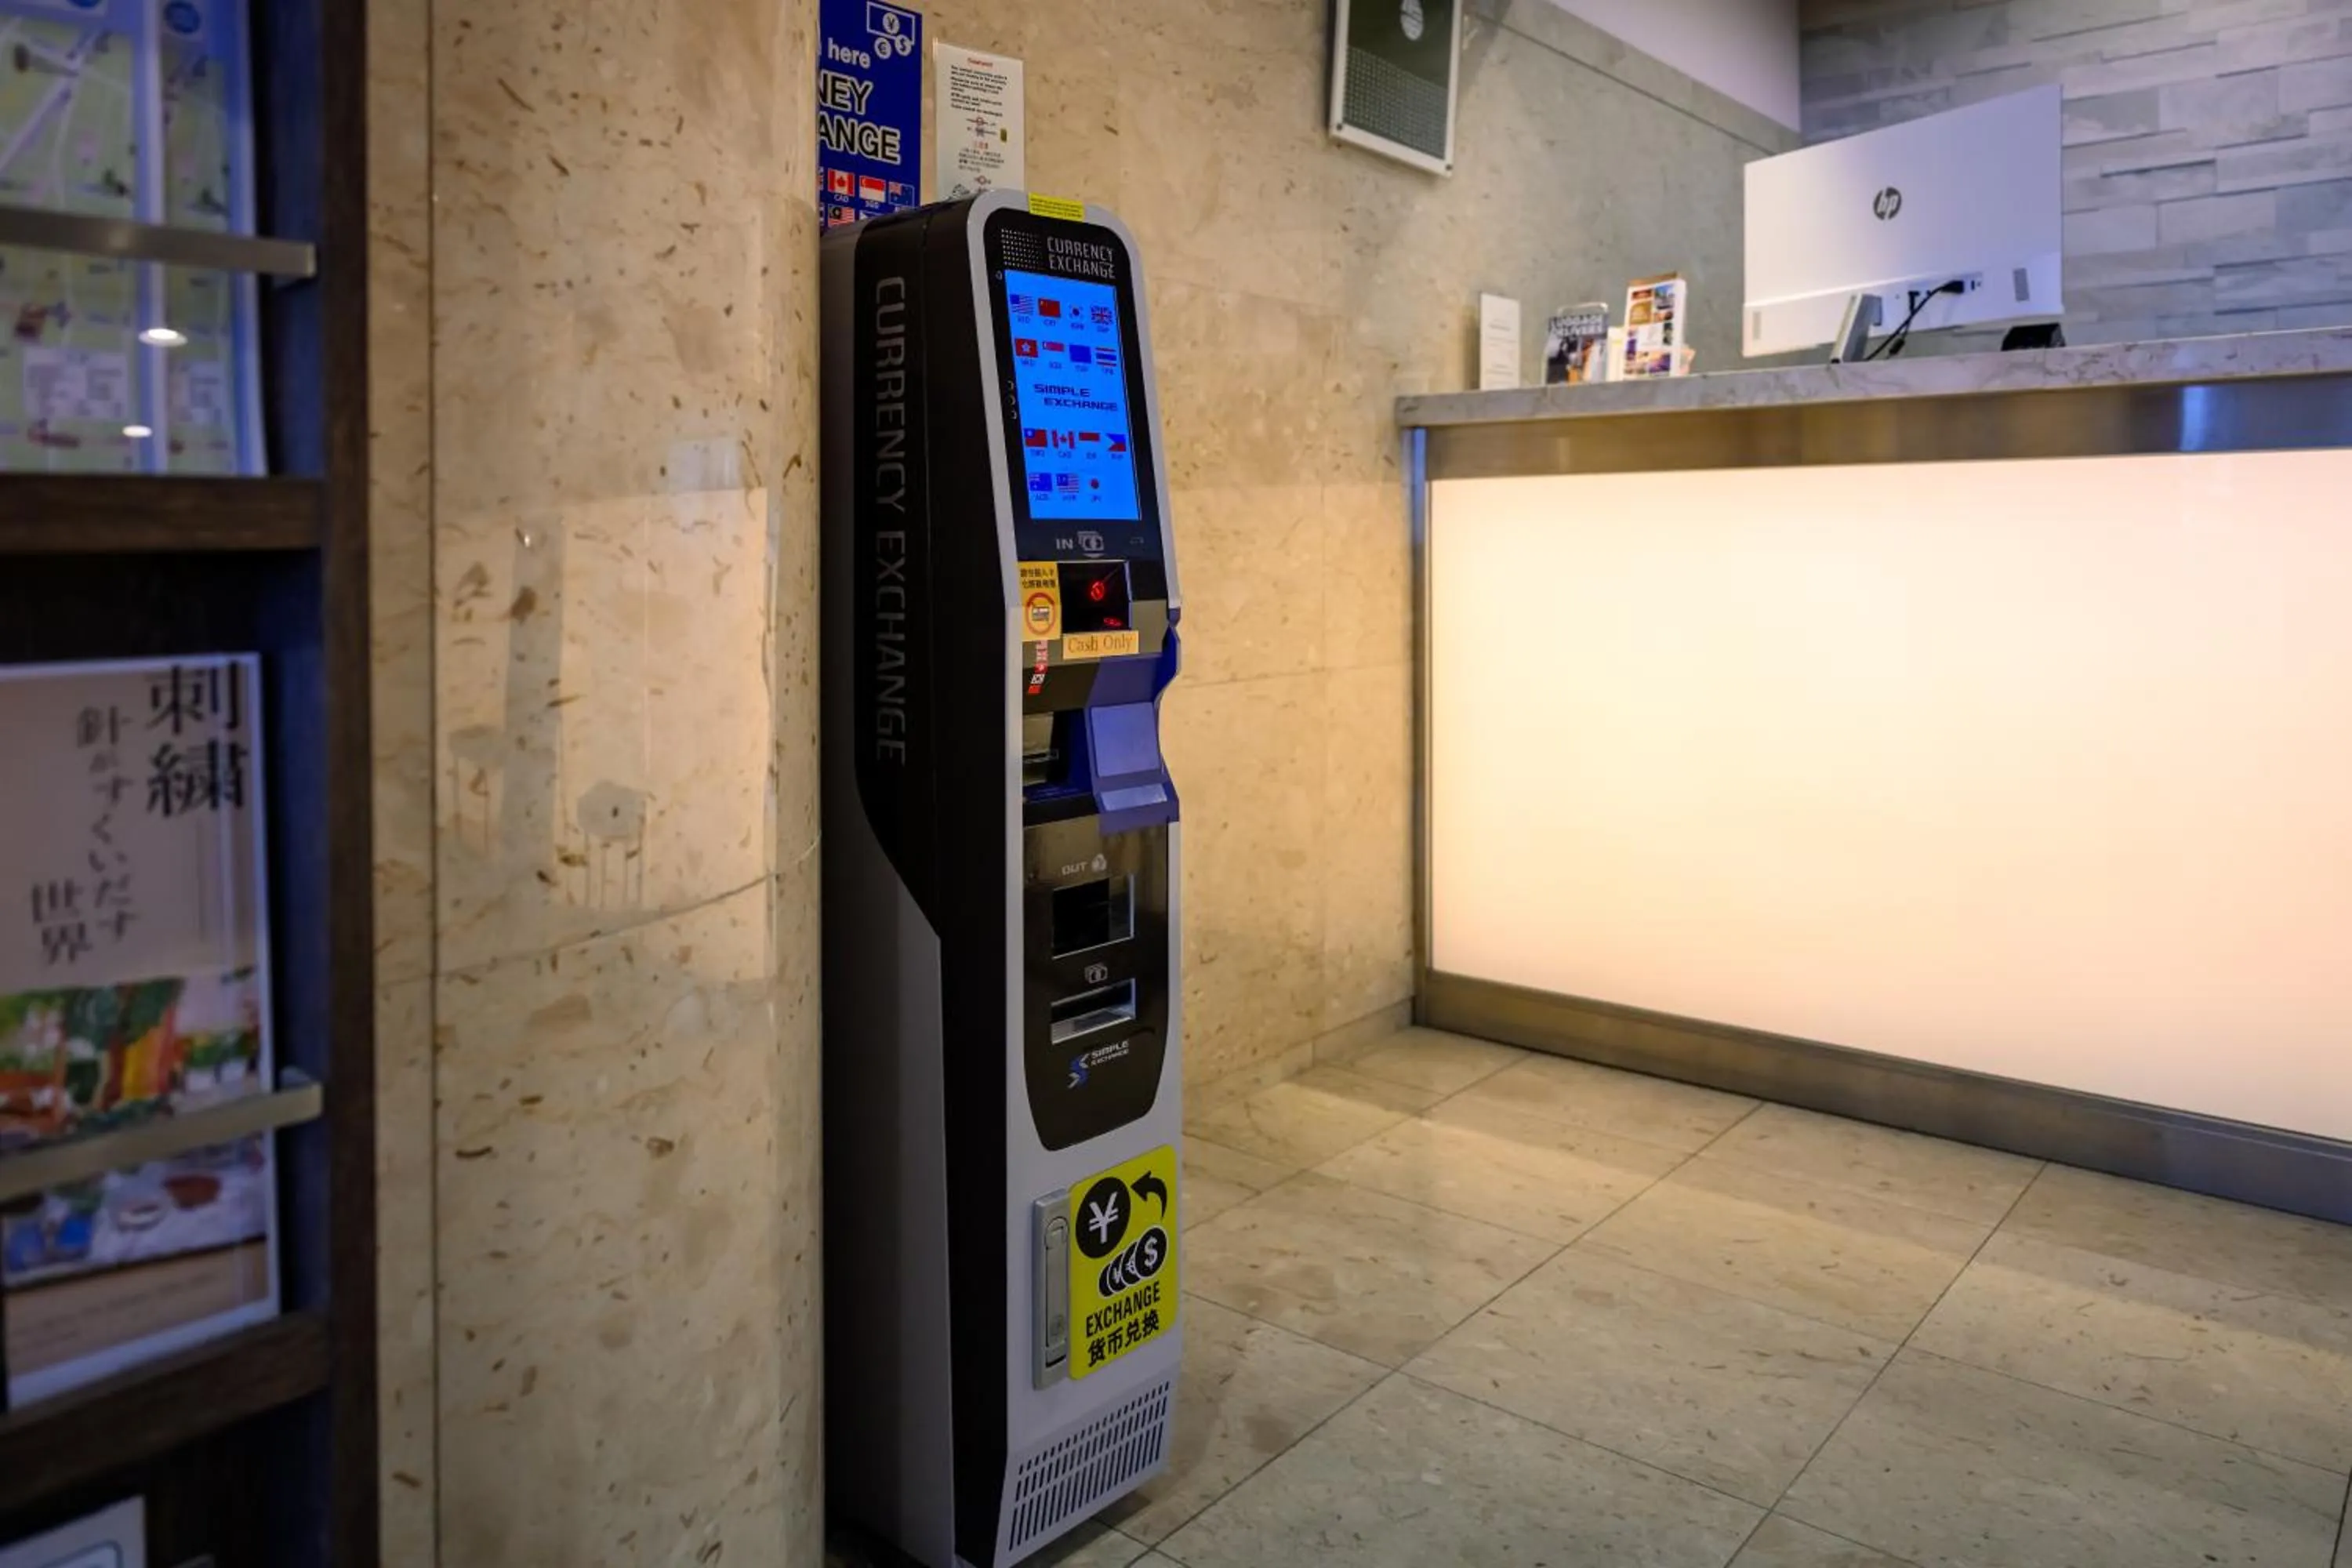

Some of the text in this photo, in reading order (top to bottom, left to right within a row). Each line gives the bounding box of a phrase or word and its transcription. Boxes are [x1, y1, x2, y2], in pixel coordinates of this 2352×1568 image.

[828, 38, 871, 69] here
[1047, 236, 1114, 262] CURRENCY
[1048, 254, 1116, 279] EXCHANGE
[1033, 383, 1091, 397] SIMPLE
[1044, 397, 1119, 412] EXCHANGE
[875, 276, 907, 768] CURRENCY EXCHANGE
[1055, 538, 1074, 550] IN
[1068, 633, 1134, 654] Cash Only
[1062, 862, 1087, 876] OUT
[27, 879, 93, 965] 世界
[1091, 1039, 1129, 1058] SIMPLE
[1086, 1279, 1161, 1338] EXCHANGE
[1087, 1308, 1160, 1368] 货币兑换
